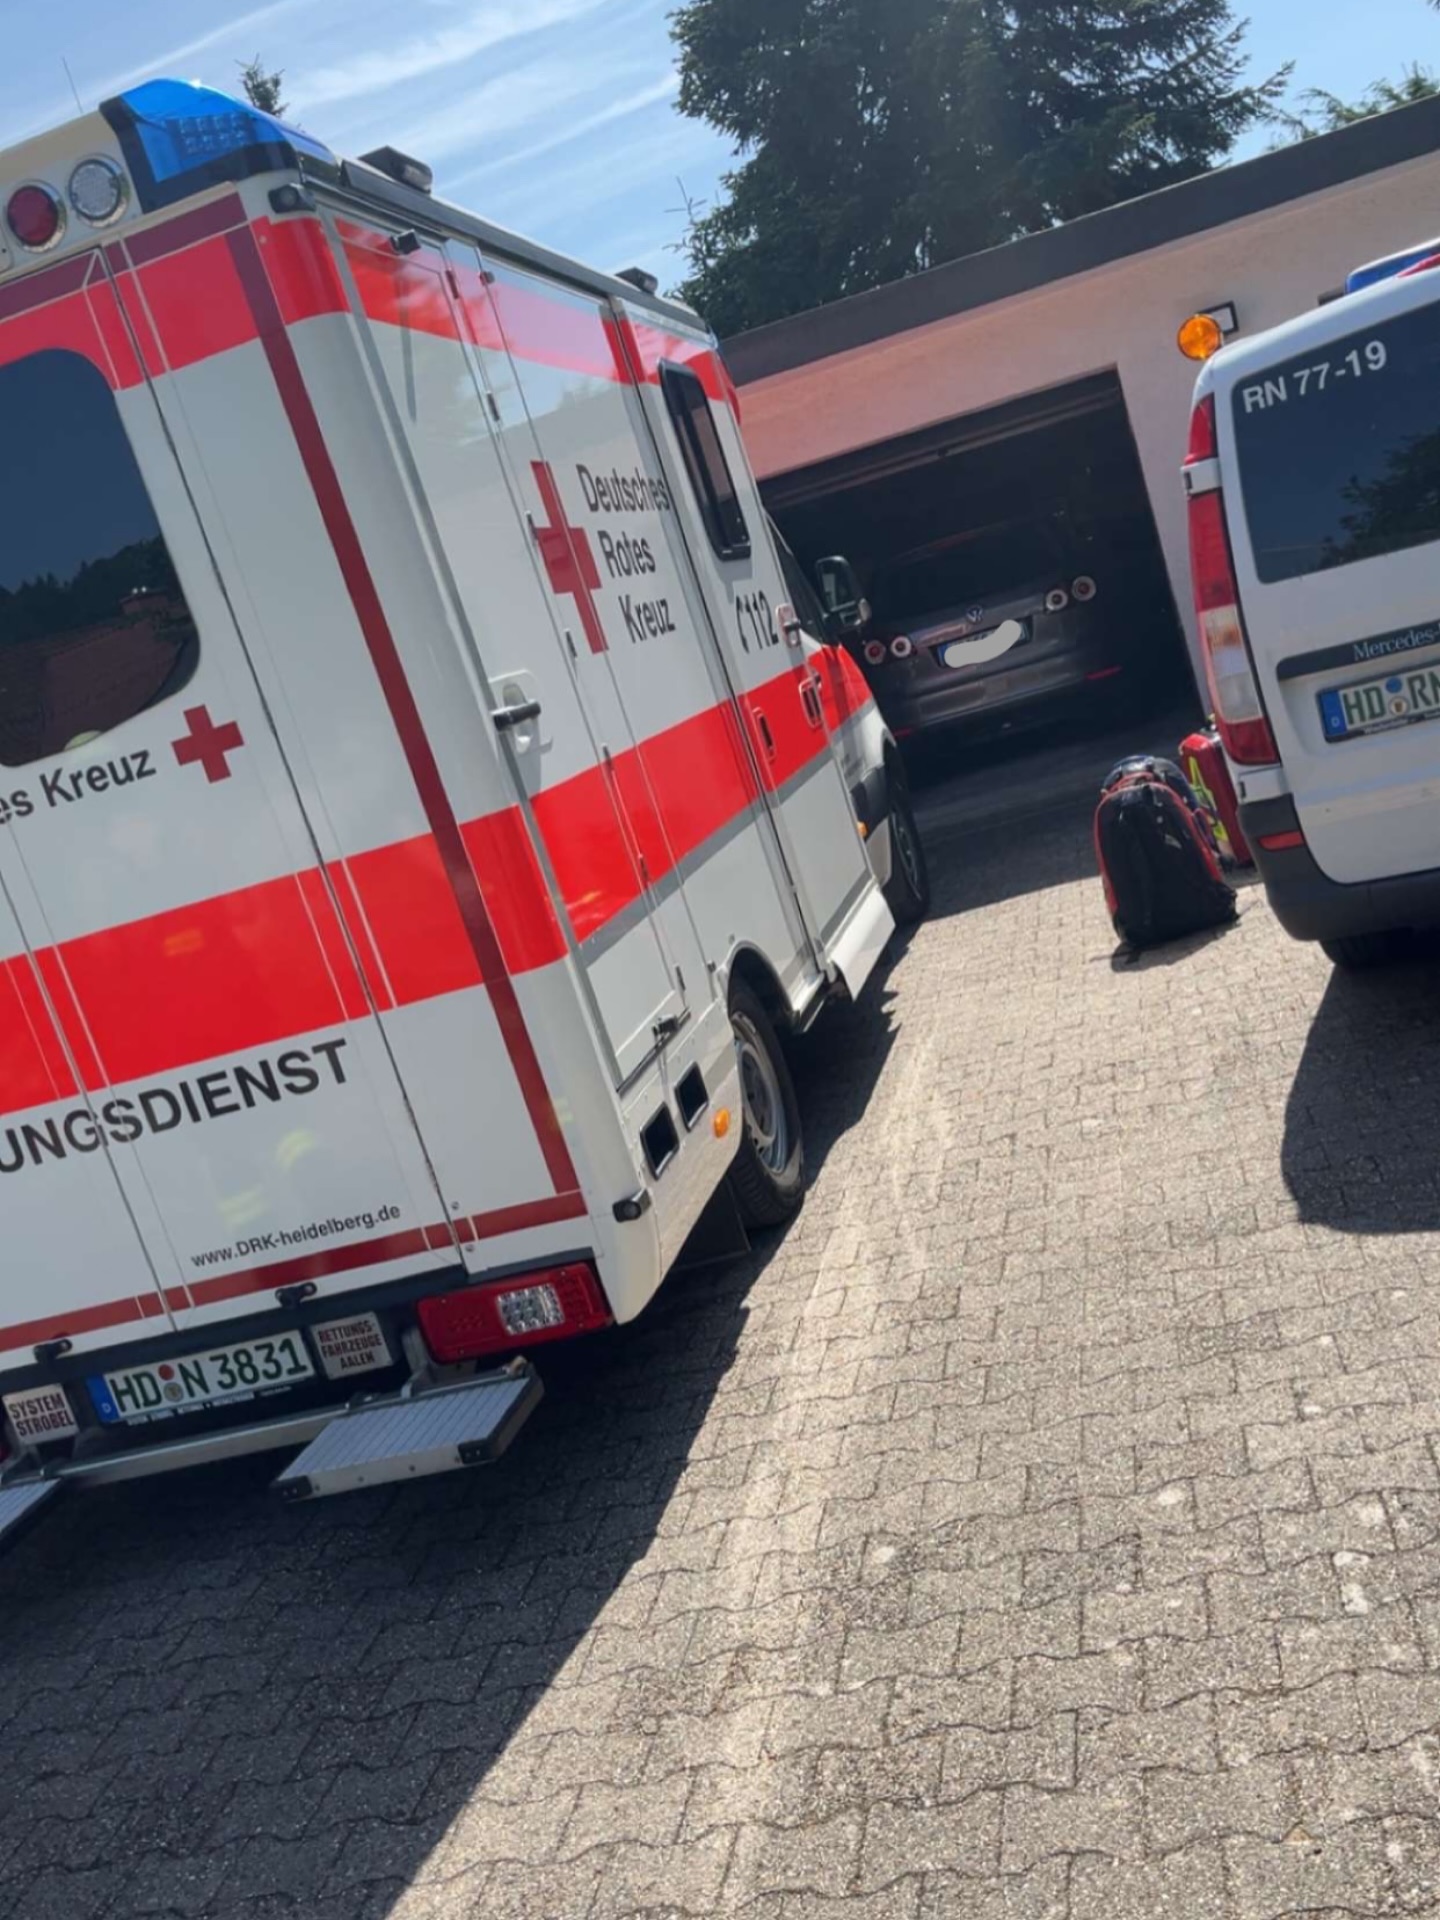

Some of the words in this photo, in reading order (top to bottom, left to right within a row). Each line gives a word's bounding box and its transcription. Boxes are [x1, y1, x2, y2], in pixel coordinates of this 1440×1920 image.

[1242, 376, 1288, 413] RN
[1293, 340, 1387, 396] 77-19
[576, 464, 671, 512] Deutsches
[597, 530, 656, 579] Rotes
[618, 594, 676, 644] Kreuz
[744, 589, 779, 650] 112
[1353, 622, 1440, 661] Mercedes-
[1343, 685, 1386, 726] HD
[39, 749, 157, 808] Kreuz
[0, 1038, 347, 1173] UNGSDIENST
[191, 1205, 400, 1267] www.DRK-heidelberg.de
[321, 1333, 383, 1358] FAHRZEUGE
[340, 1350, 375, 1370] AALEN
[109, 1371, 163, 1413] HD
[178, 1359, 210, 1398] N
[209, 1337, 308, 1390] 3831
[8, 1391, 66, 1419] SYSTEM
[15, 1409, 74, 1436] STROBEL
